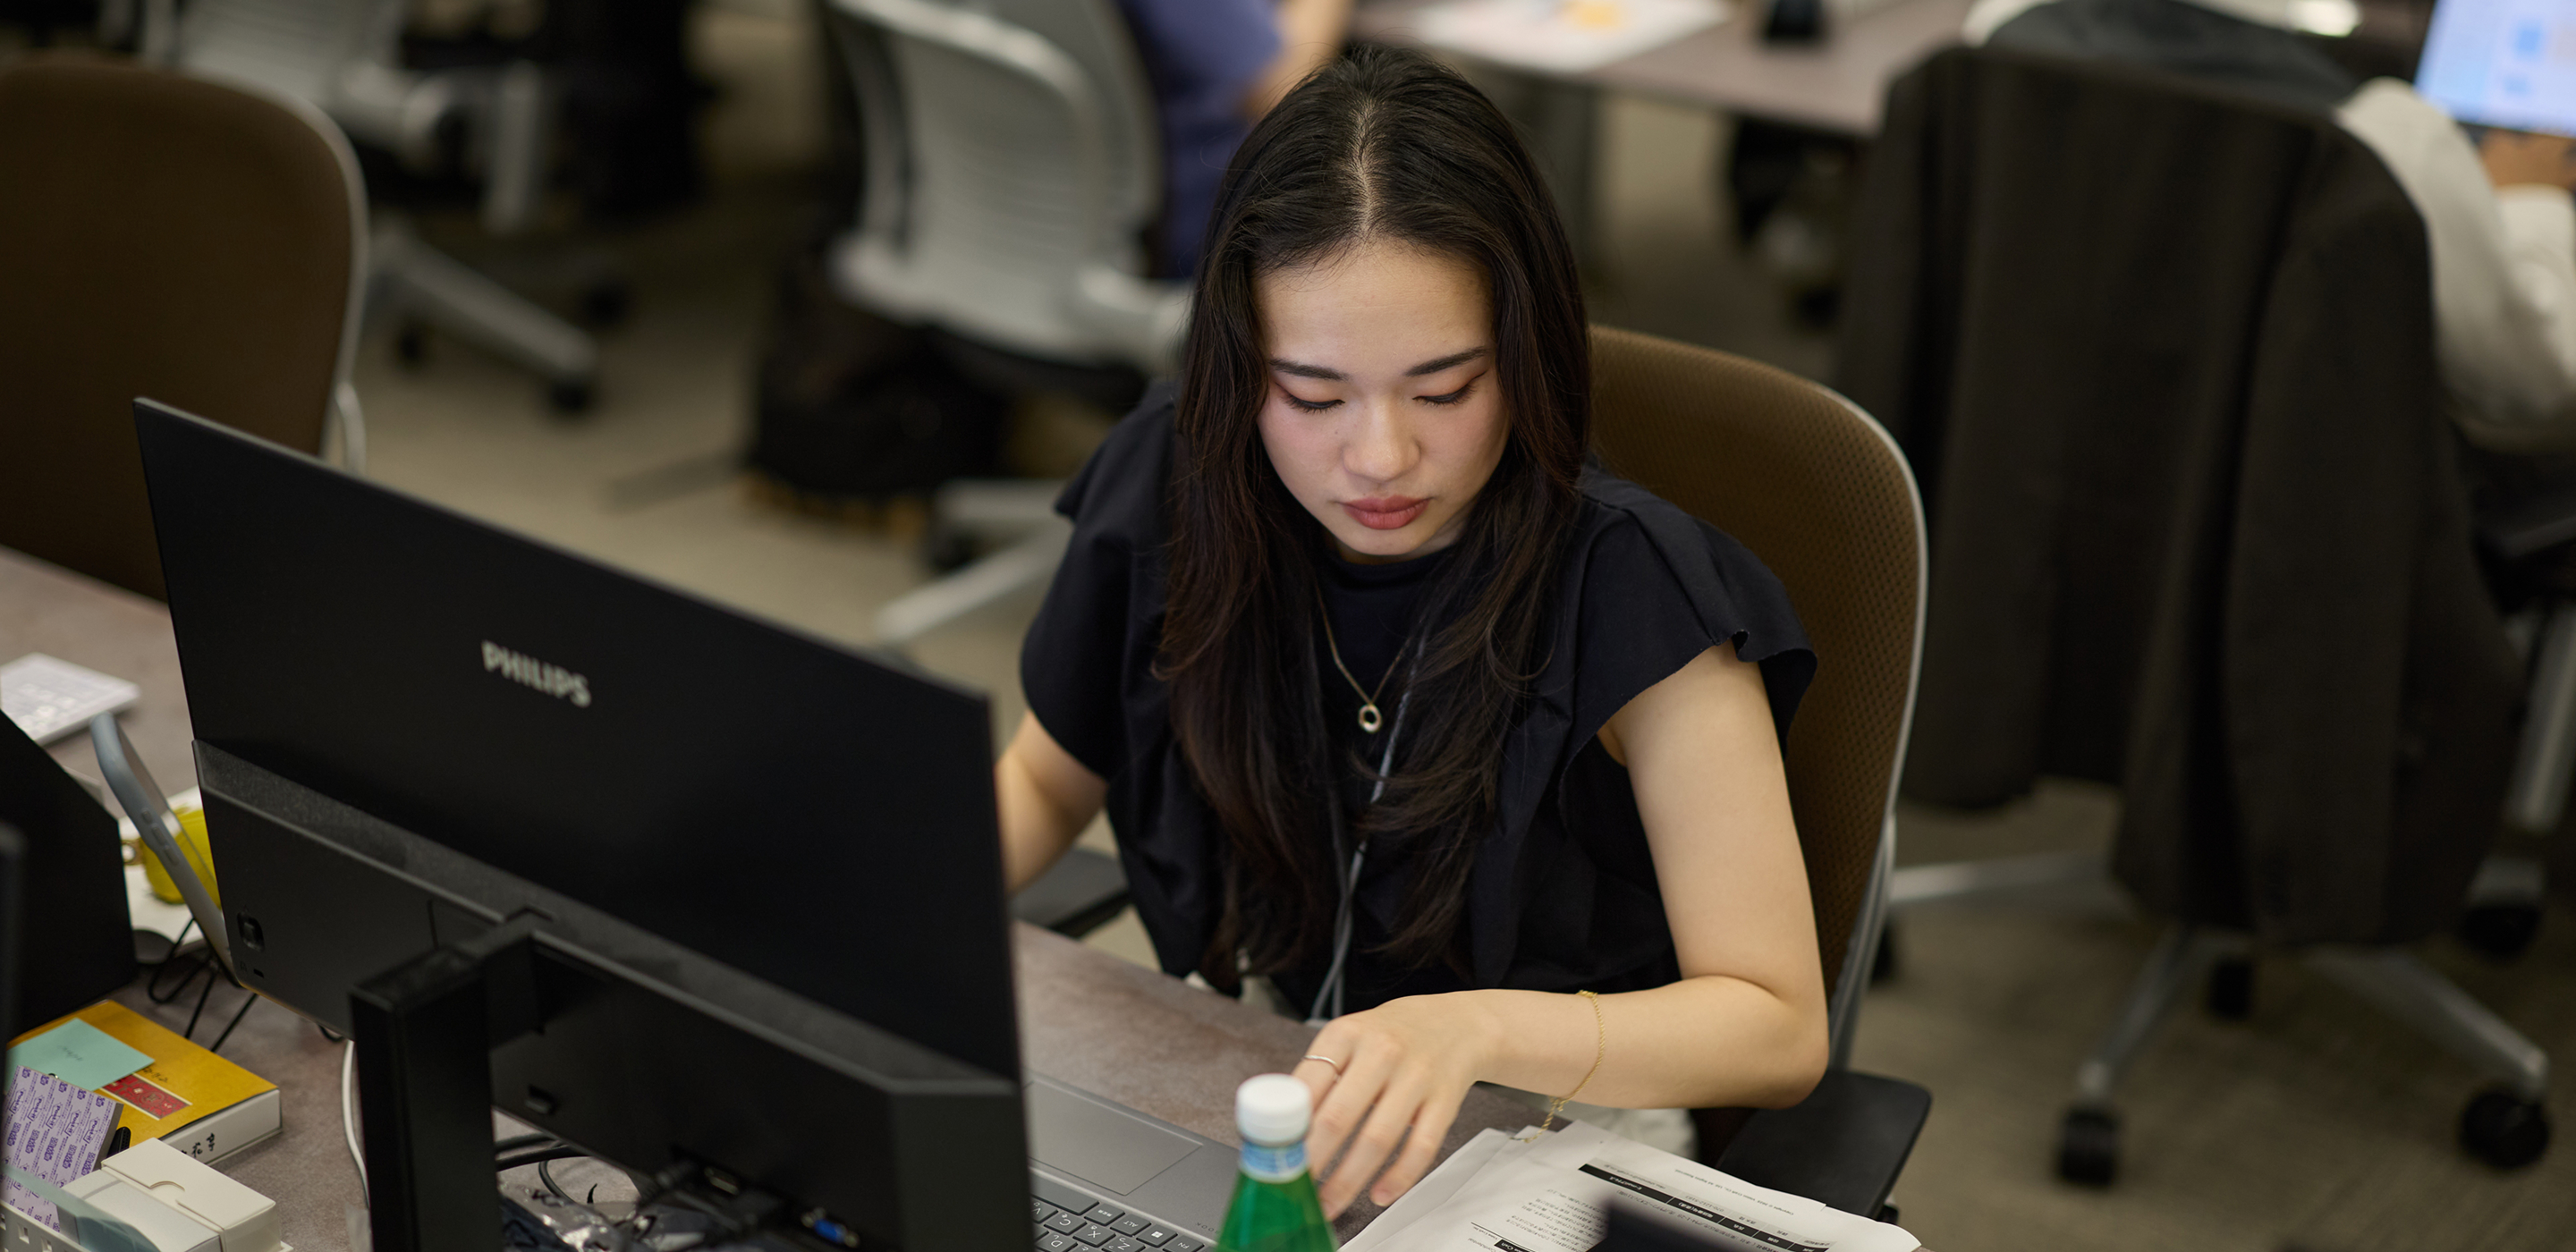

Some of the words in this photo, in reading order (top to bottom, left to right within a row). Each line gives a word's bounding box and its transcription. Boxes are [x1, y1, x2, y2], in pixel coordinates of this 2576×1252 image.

[480, 639, 592, 708] PHILIPS
[1059, 1218, 1072, 1226] C
[1123, 1220, 1140, 1228] ALT
[1088, 1230, 1101, 1239] X
[1050, 1239, 1063, 1248] D
[1117, 1242, 1131, 1250] Z
